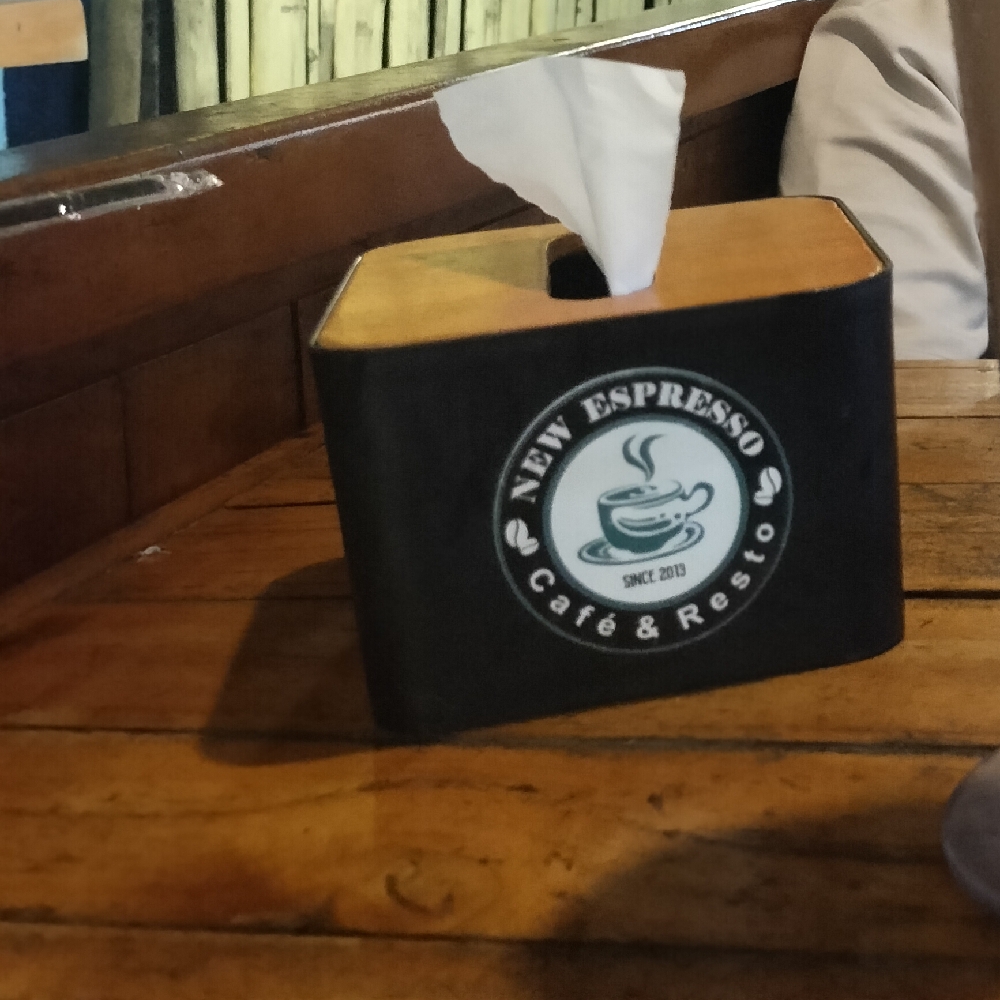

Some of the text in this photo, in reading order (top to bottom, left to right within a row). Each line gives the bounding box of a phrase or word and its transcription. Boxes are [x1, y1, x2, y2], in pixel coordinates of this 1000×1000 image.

[510, 381, 765, 503] NEW ESPRESSO
[529, 521, 775, 640] Café & Resto
[622, 563, 687, 588] SINCE 2013
